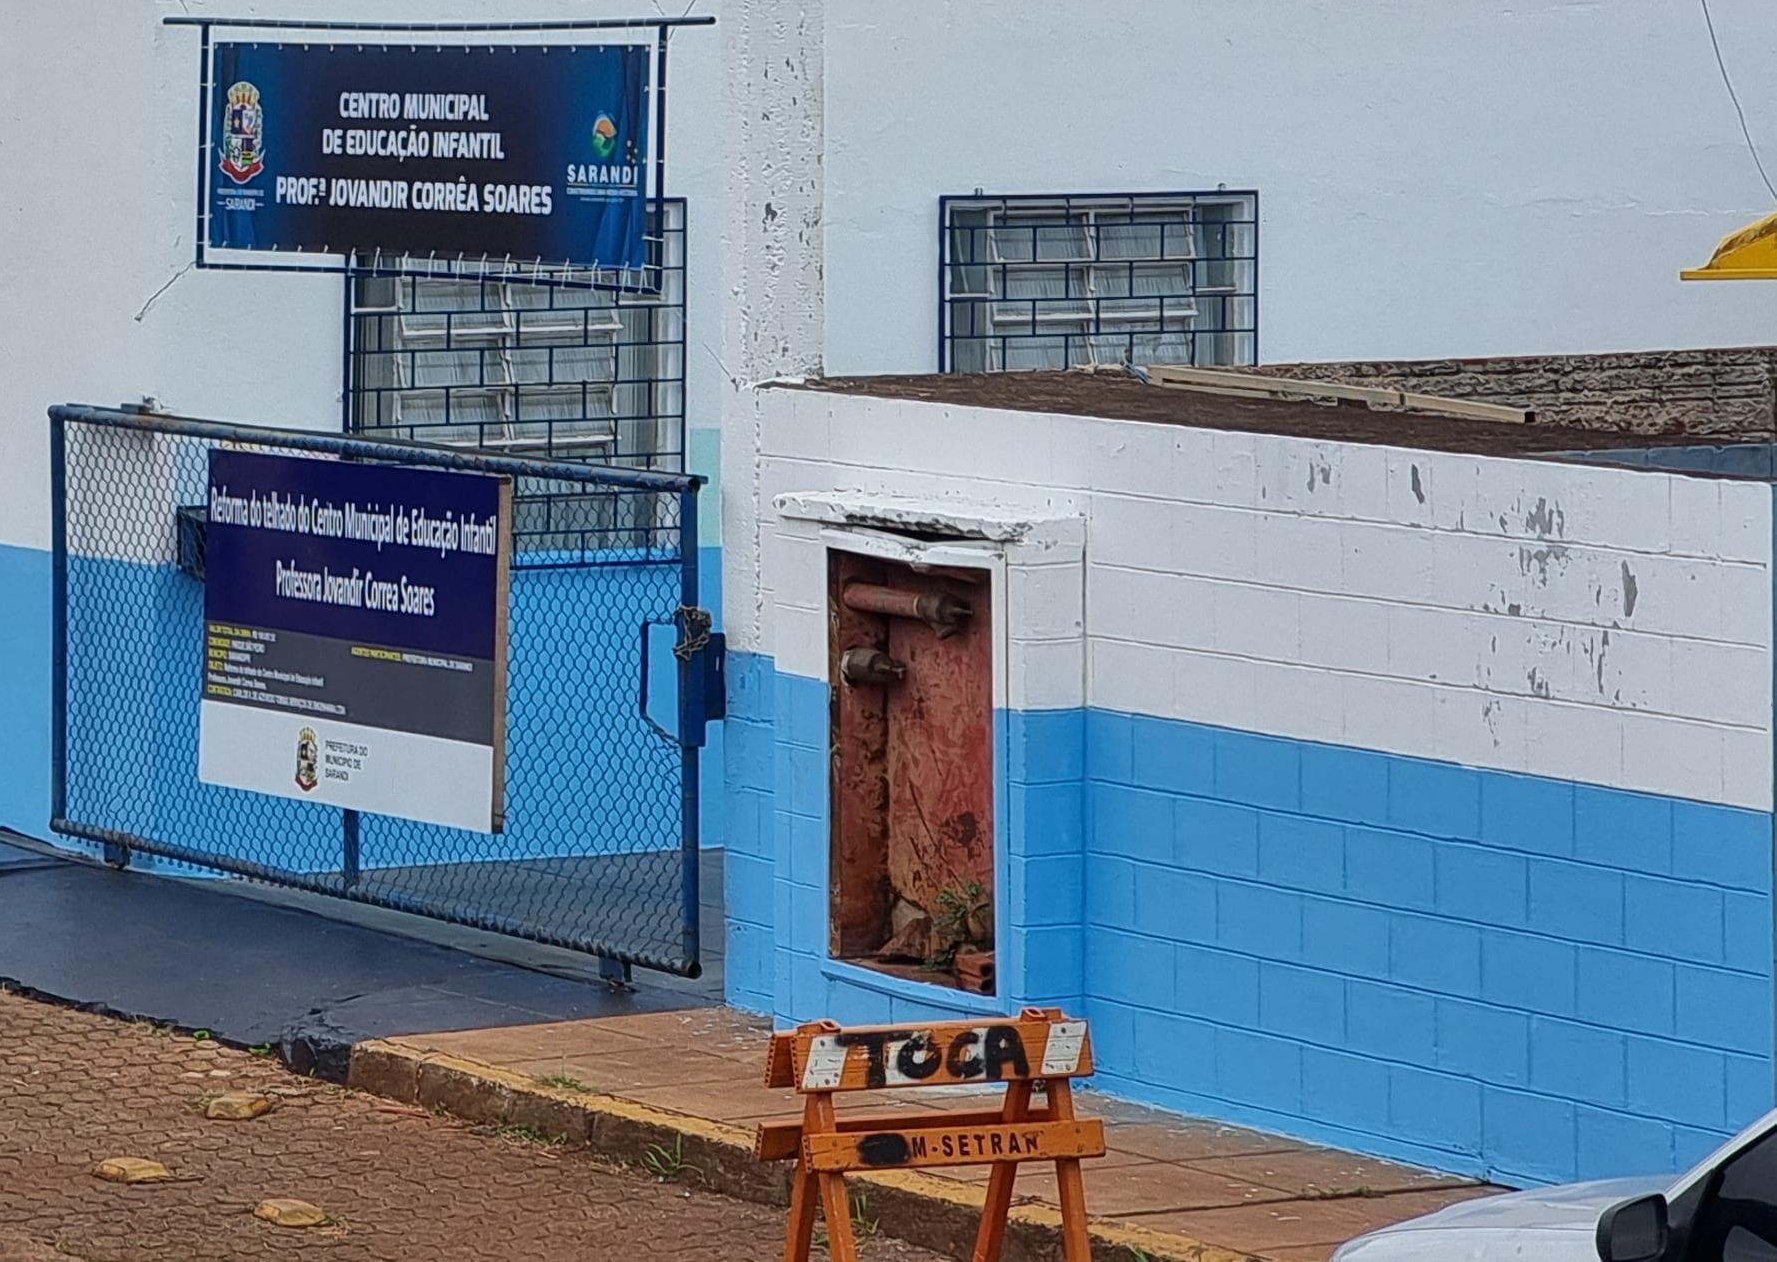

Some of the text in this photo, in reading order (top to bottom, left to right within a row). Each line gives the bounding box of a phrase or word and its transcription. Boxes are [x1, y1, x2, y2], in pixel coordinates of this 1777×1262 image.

[339, 92, 489, 121] CENTRO MUNICIPAL
[322, 124, 505, 162] DE EDUCAÇÃO INFANTIL
[567, 163, 638, 185] SARANDI
[329, 178, 408, 209] JOVANDIR
[412, 175, 479, 211] CORRÊA
[483, 184, 552, 215] SOARES
[211, 485, 497, 559] Reforma do telhado do Centro Municipal de Educação Infantil
[276, 559, 435, 616] Professora Jovandir Correa Soares
[835, 1025, 1030, 1087] TOCA
